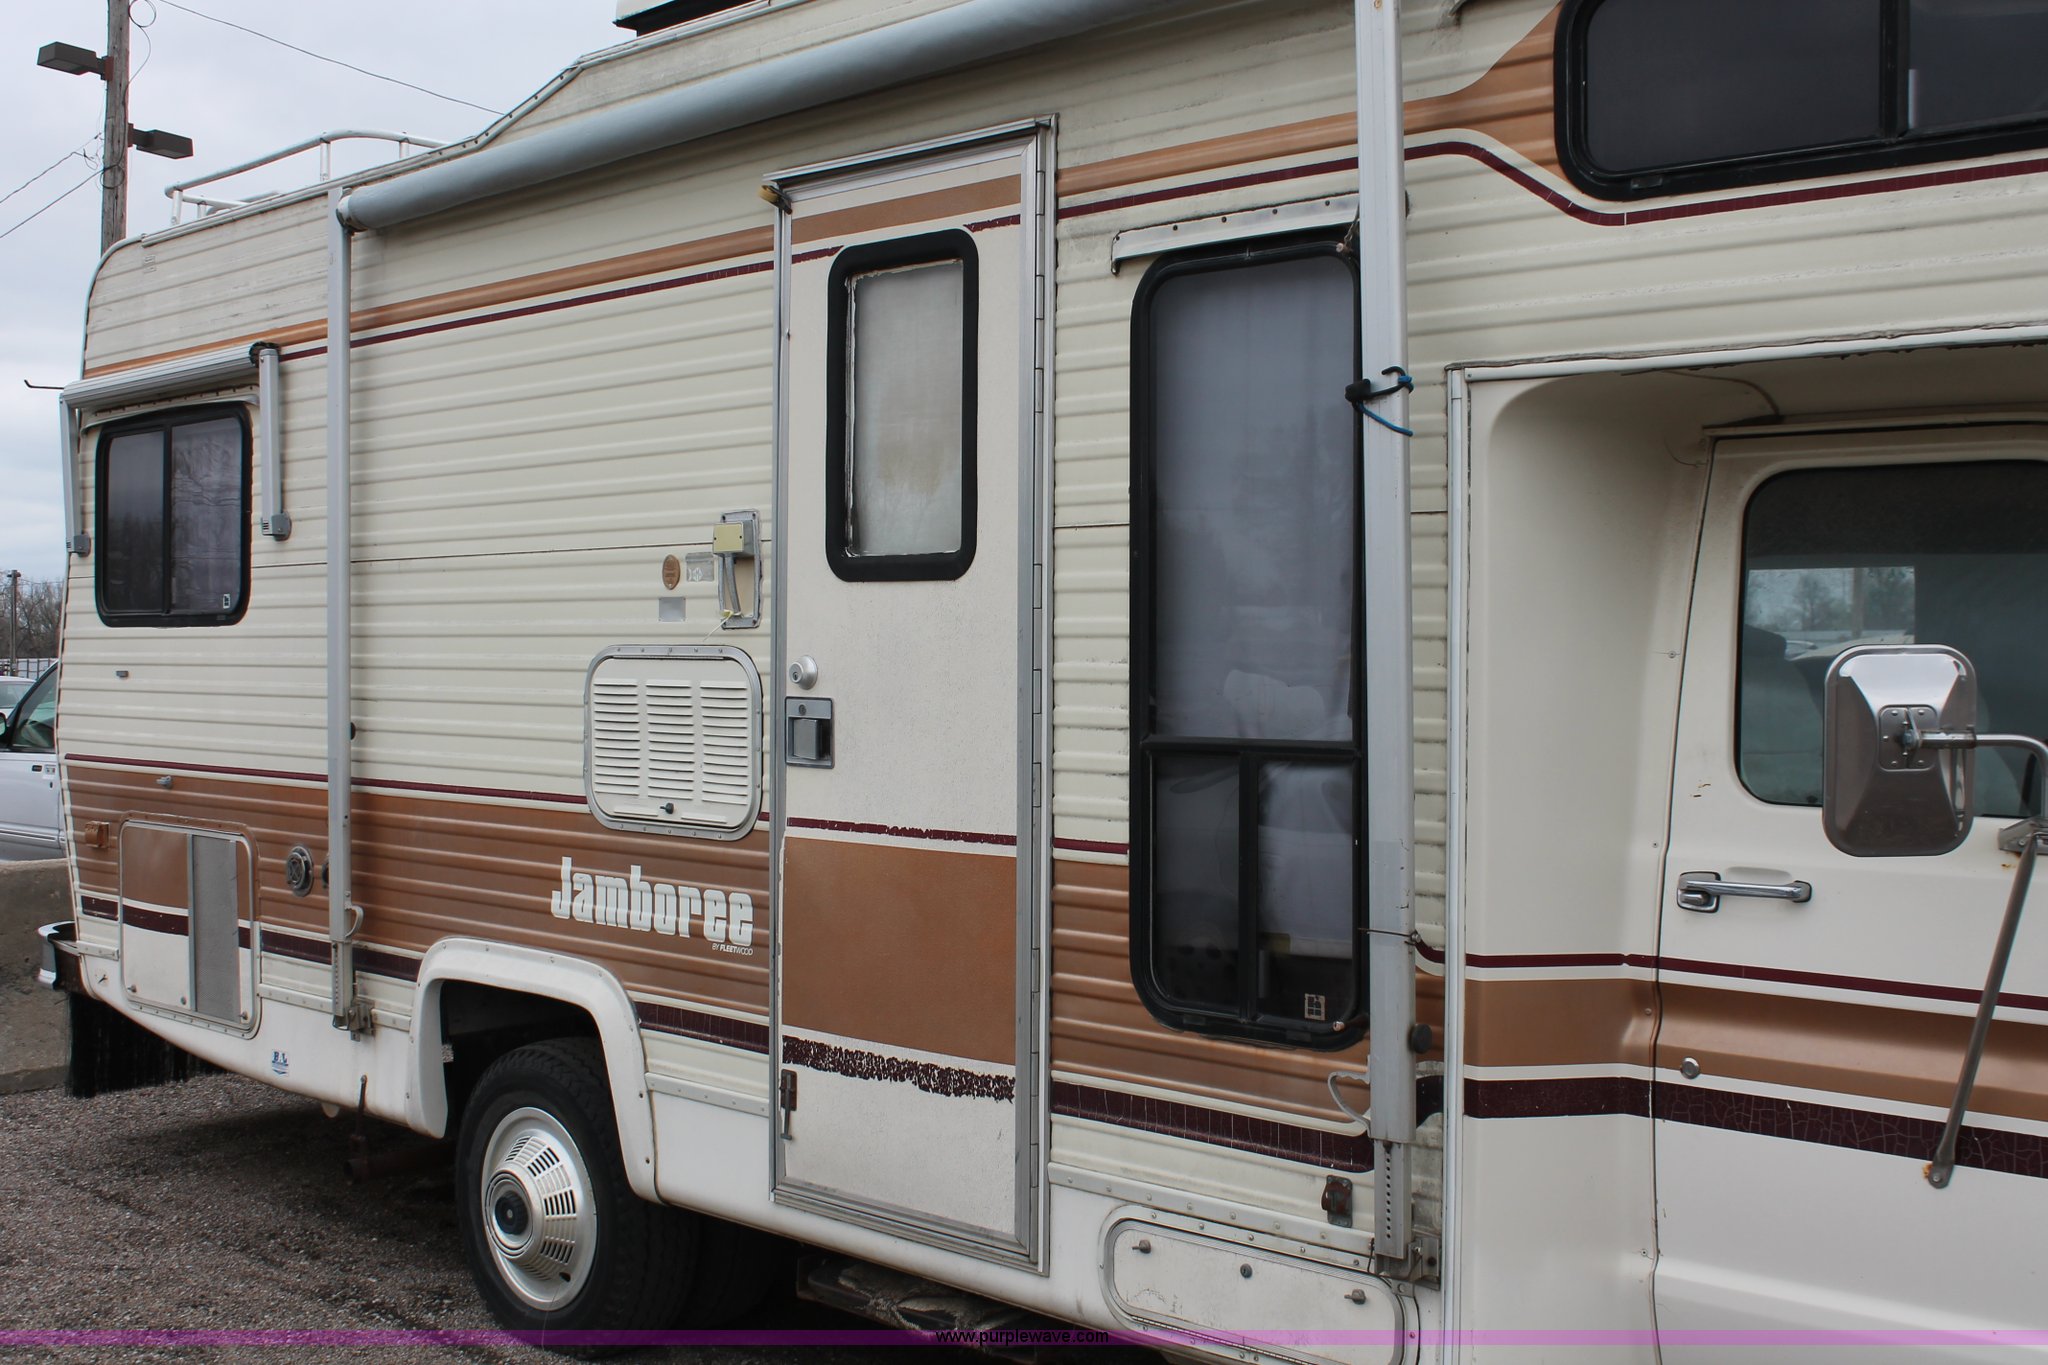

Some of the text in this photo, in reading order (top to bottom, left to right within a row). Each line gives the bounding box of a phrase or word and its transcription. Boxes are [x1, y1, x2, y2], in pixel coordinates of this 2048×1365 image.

[551, 856, 753, 946] Jamboree
[712, 943, 753, 955] BY FLEETWOOD
